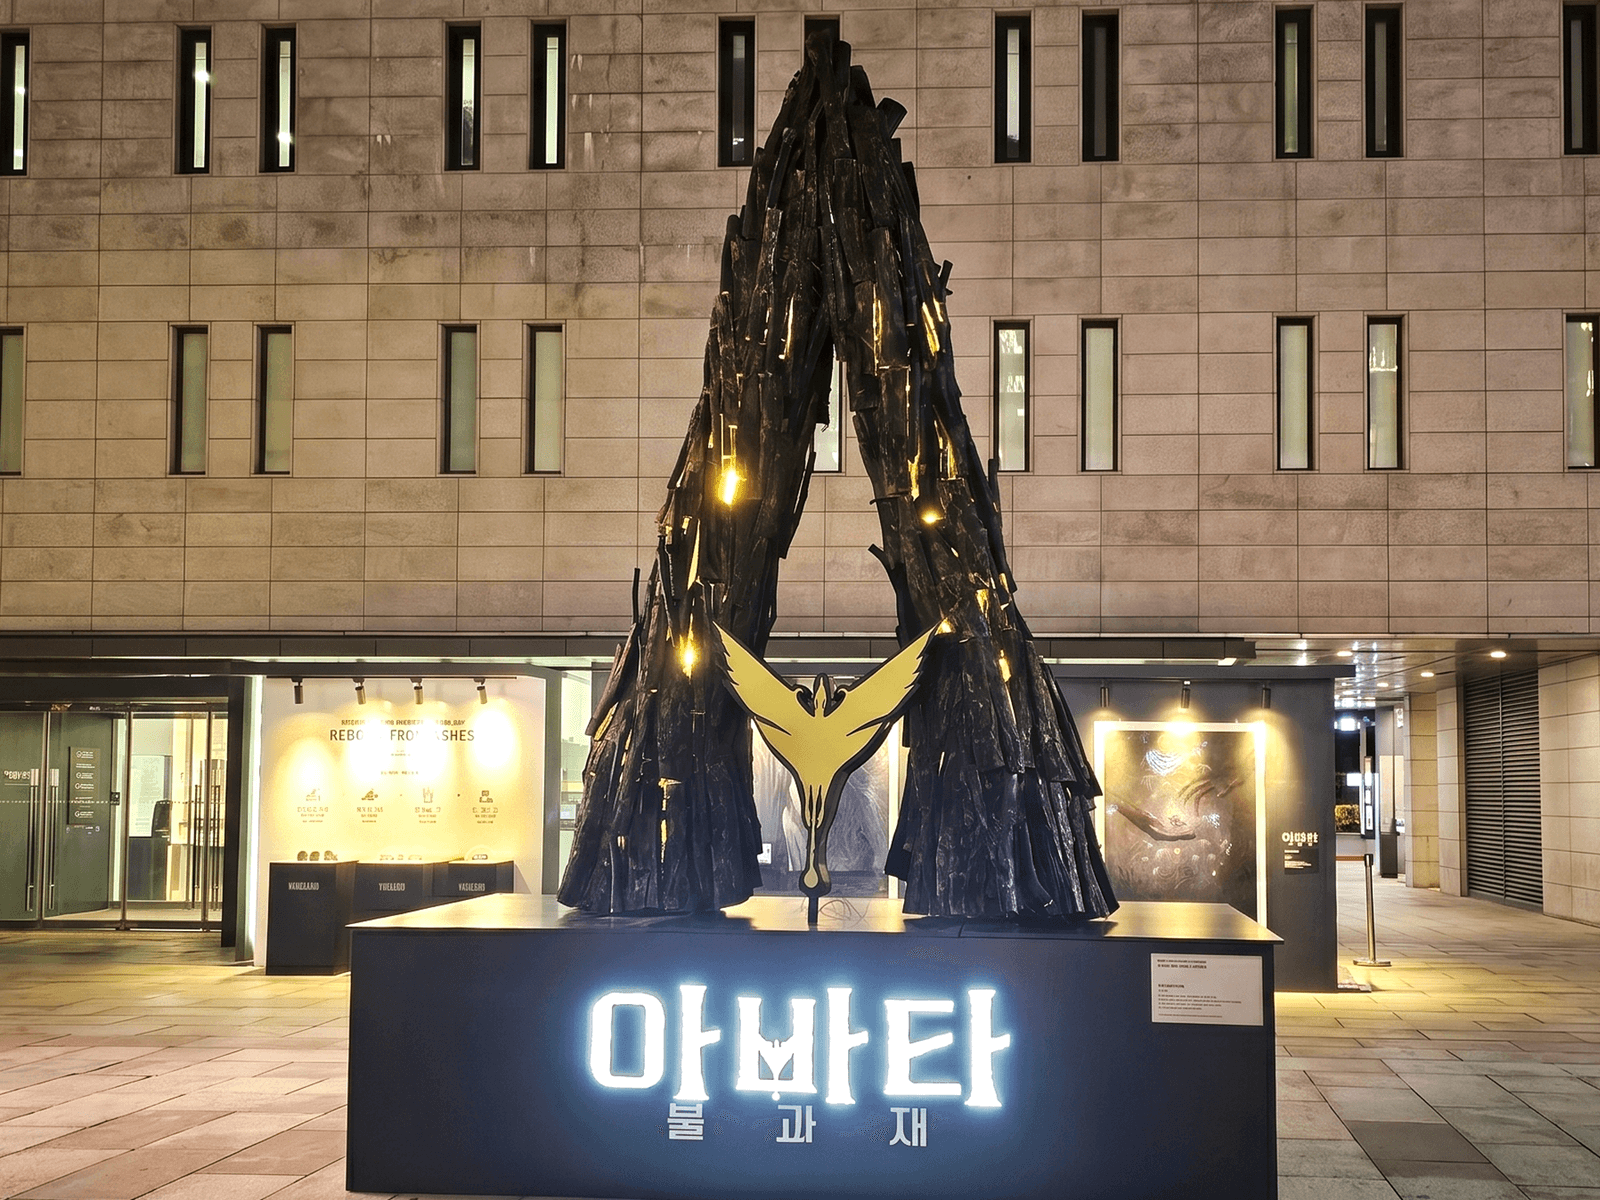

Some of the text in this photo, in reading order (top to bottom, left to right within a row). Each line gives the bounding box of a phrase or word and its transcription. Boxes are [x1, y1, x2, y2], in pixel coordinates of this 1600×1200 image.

[329, 729, 381, 741] REBO
[390, 729, 426, 741] FRO
[589, 984, 1011, 1107] 아바타
[667, 1103, 927, 1147] 불 과 재
